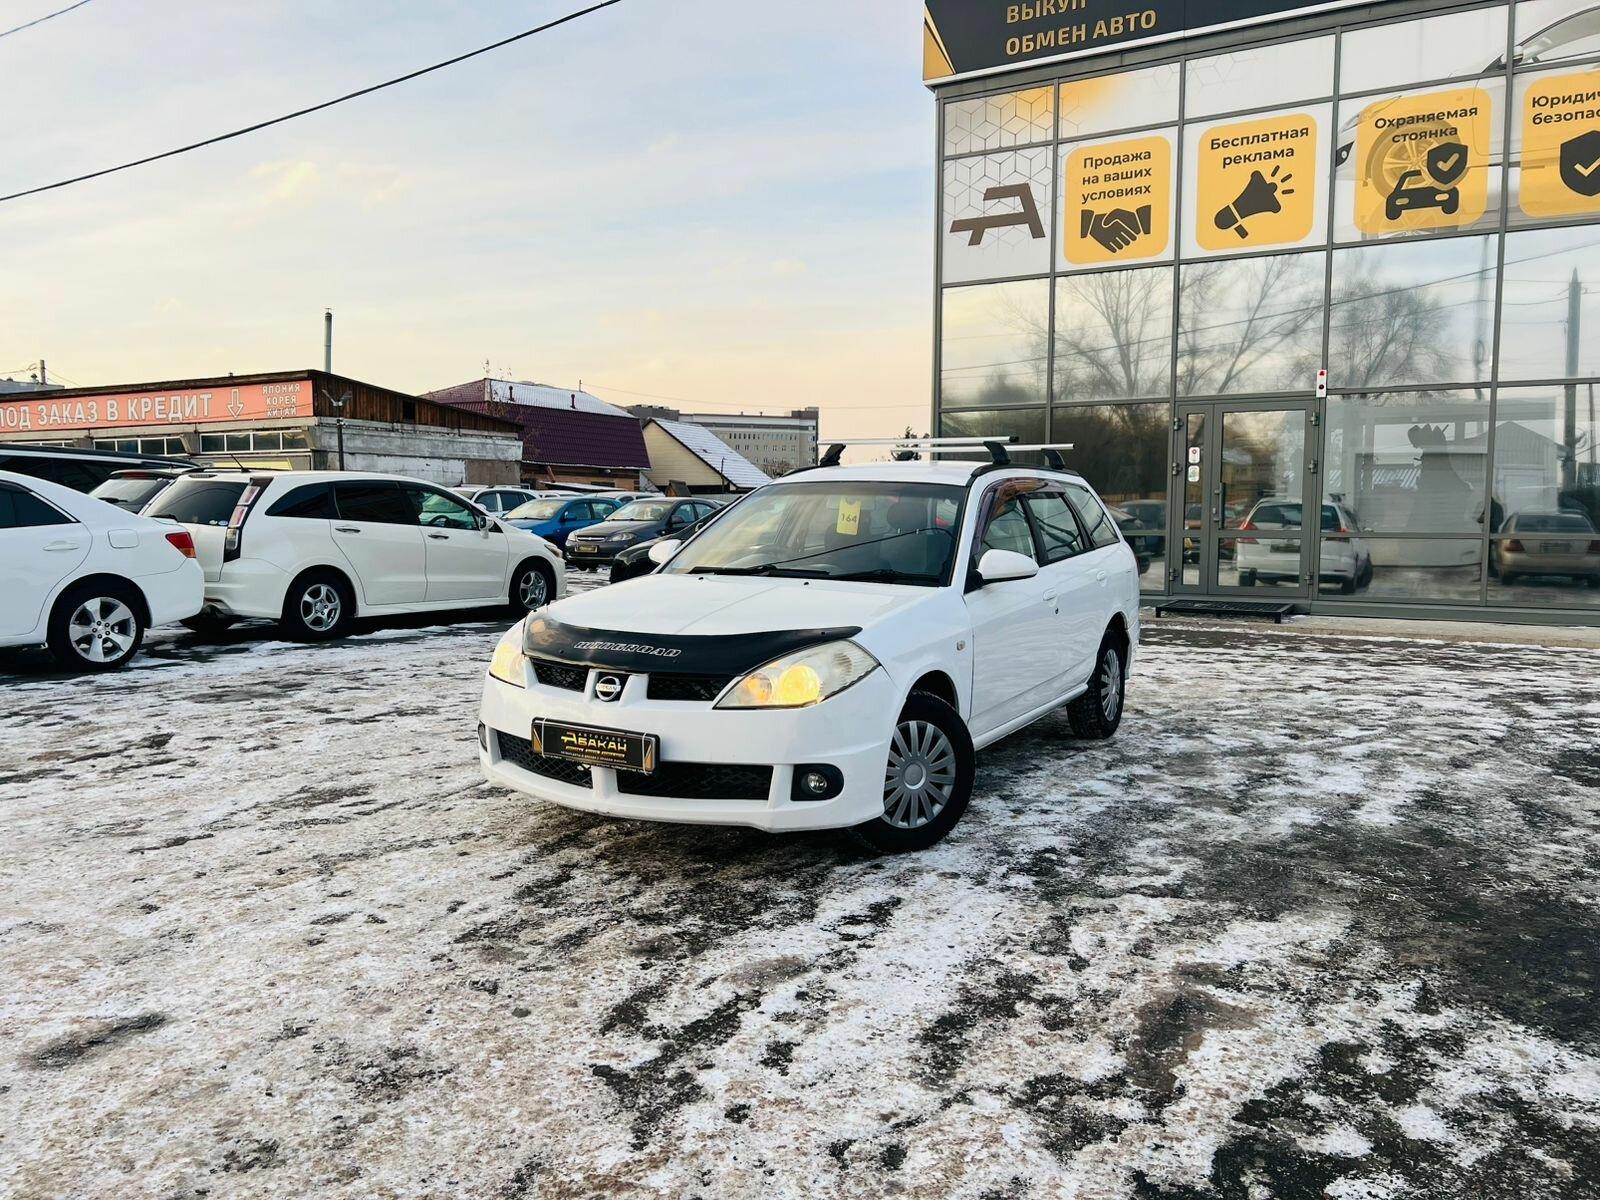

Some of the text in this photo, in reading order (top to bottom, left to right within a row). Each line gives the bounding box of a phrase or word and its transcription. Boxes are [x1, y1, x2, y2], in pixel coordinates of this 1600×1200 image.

[1005, 10, 1157, 56] ОБМЕН АВТО
[1532, 91, 1600, 108] Юриди
[1374, 107, 1478, 129] Охраняемая
[1210, 127, 1309, 150] Бесплатная
[1392, 127, 1458, 143] стоянка
[1083, 151, 1152, 169] Продажа
[1223, 147, 1295, 169] реклама
[1082, 167, 1152, 186] на ваших
[1081, 184, 1152, 205] условиях
[262, 383, 300, 394] ЯПОНИЯ
[38, 400, 98, 426] ЗАКАЗ
[106, 399, 119, 421] В
[127, 393, 213, 422] КРЕДИТ
[266, 395, 297, 406] КОРЕЯ
[267, 406, 297, 417] КИТАЙ
[841, 513, 857, 522] 164
[574, 641, 682, 658] WINGROAD
